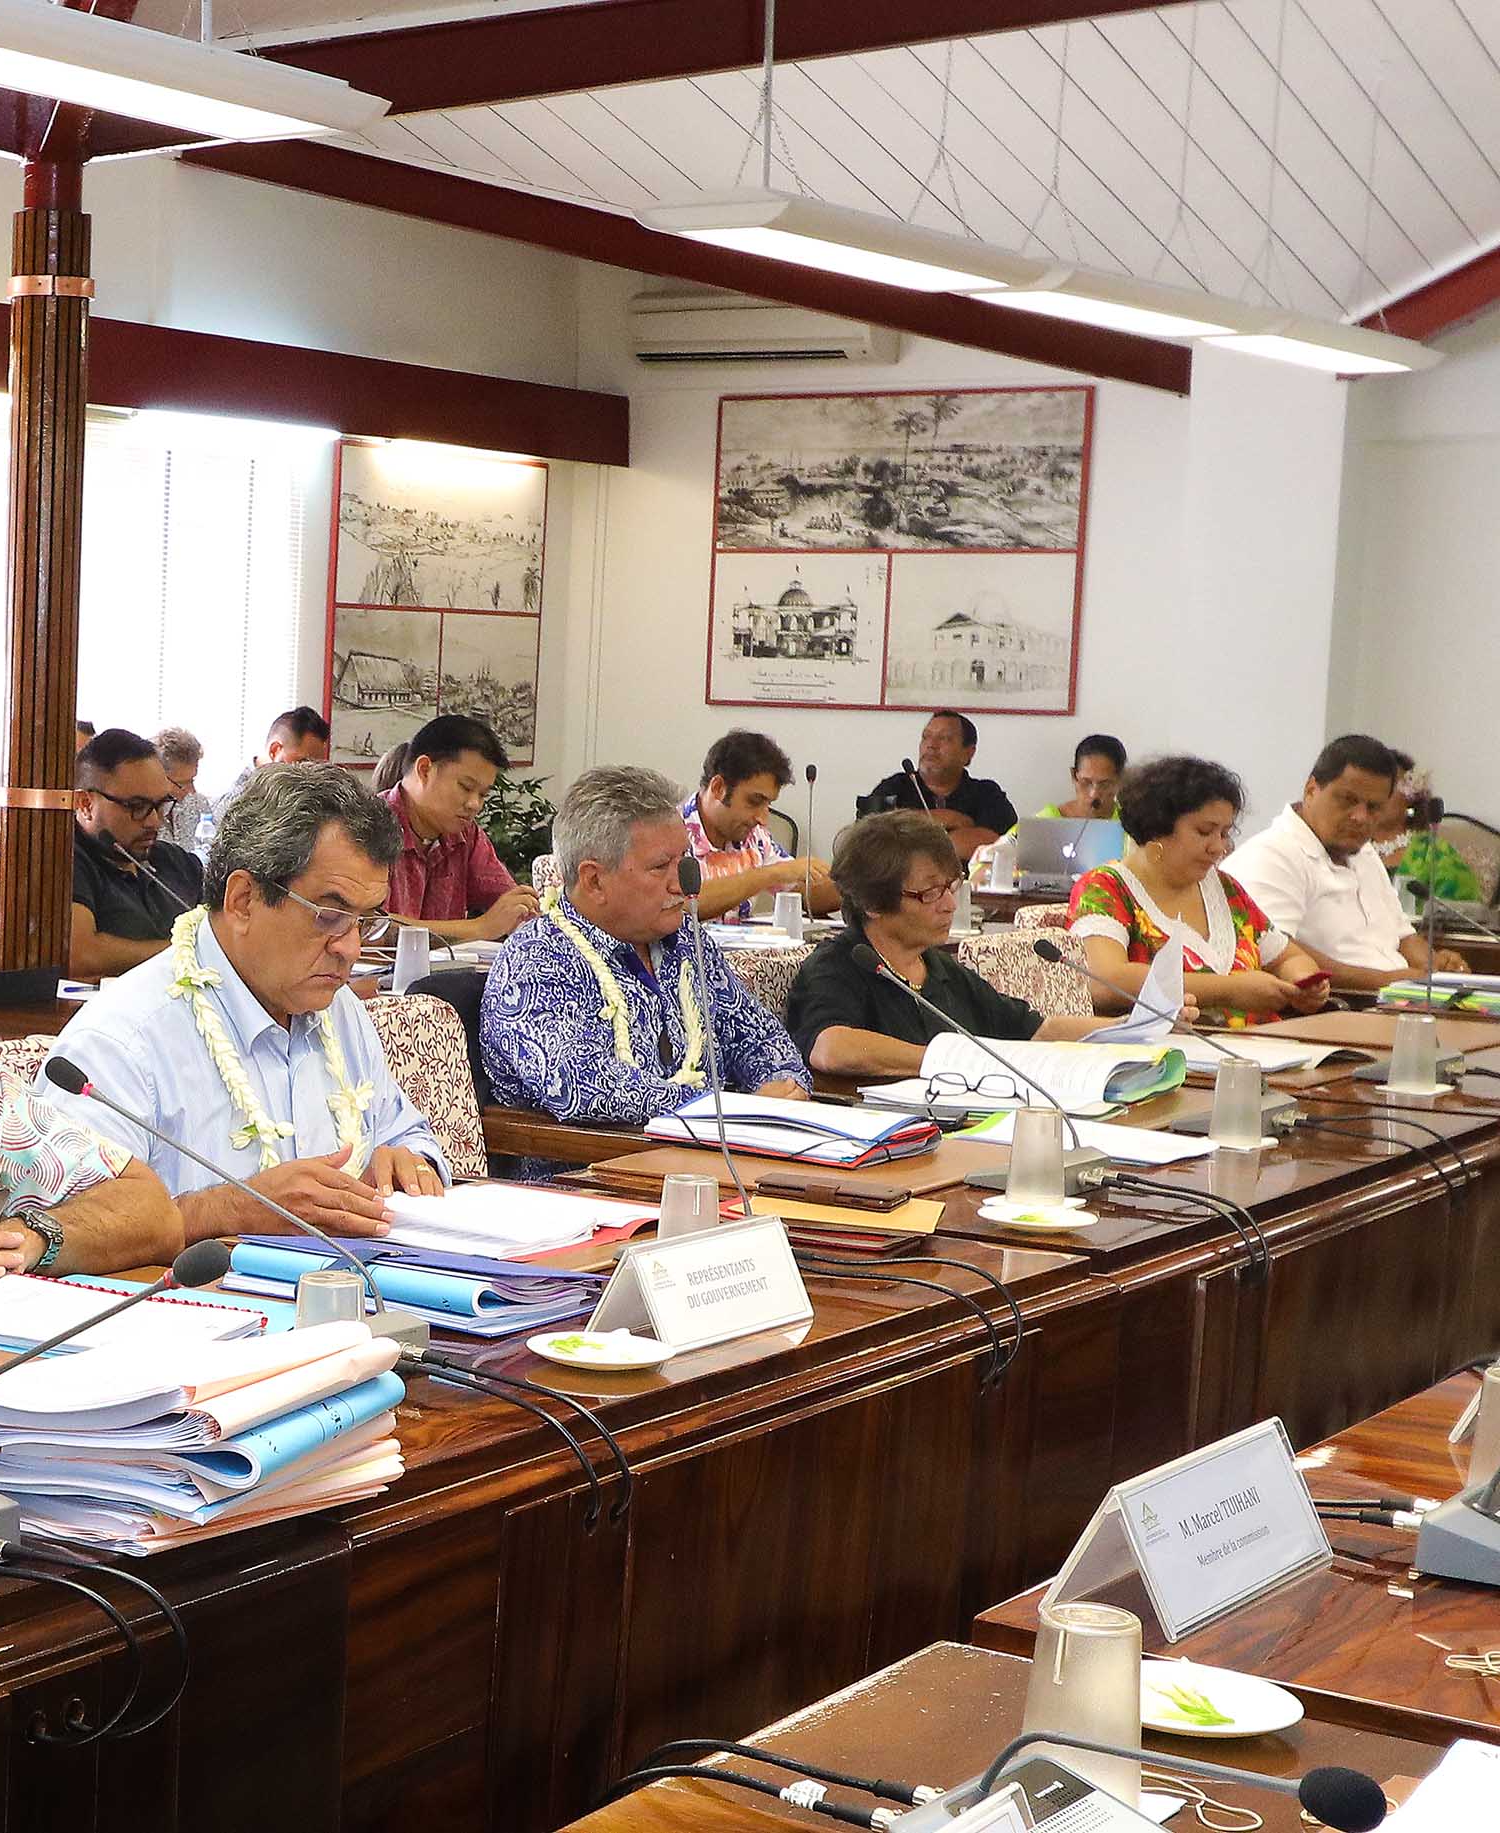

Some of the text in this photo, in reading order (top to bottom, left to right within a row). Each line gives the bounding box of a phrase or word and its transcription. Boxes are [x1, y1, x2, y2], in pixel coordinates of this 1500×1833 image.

[686, 1257, 757, 1287] REPRÉSENTANTS
[686, 1276, 770, 1310] DU GOUVERNEMENT
[1178, 1519, 1195, 1540] M.
[1191, 1503, 1224, 1534] Marcel
[1219, 1486, 1261, 1519] TUIHANI
[1196, 1525, 1271, 1568] Membre de la commission
